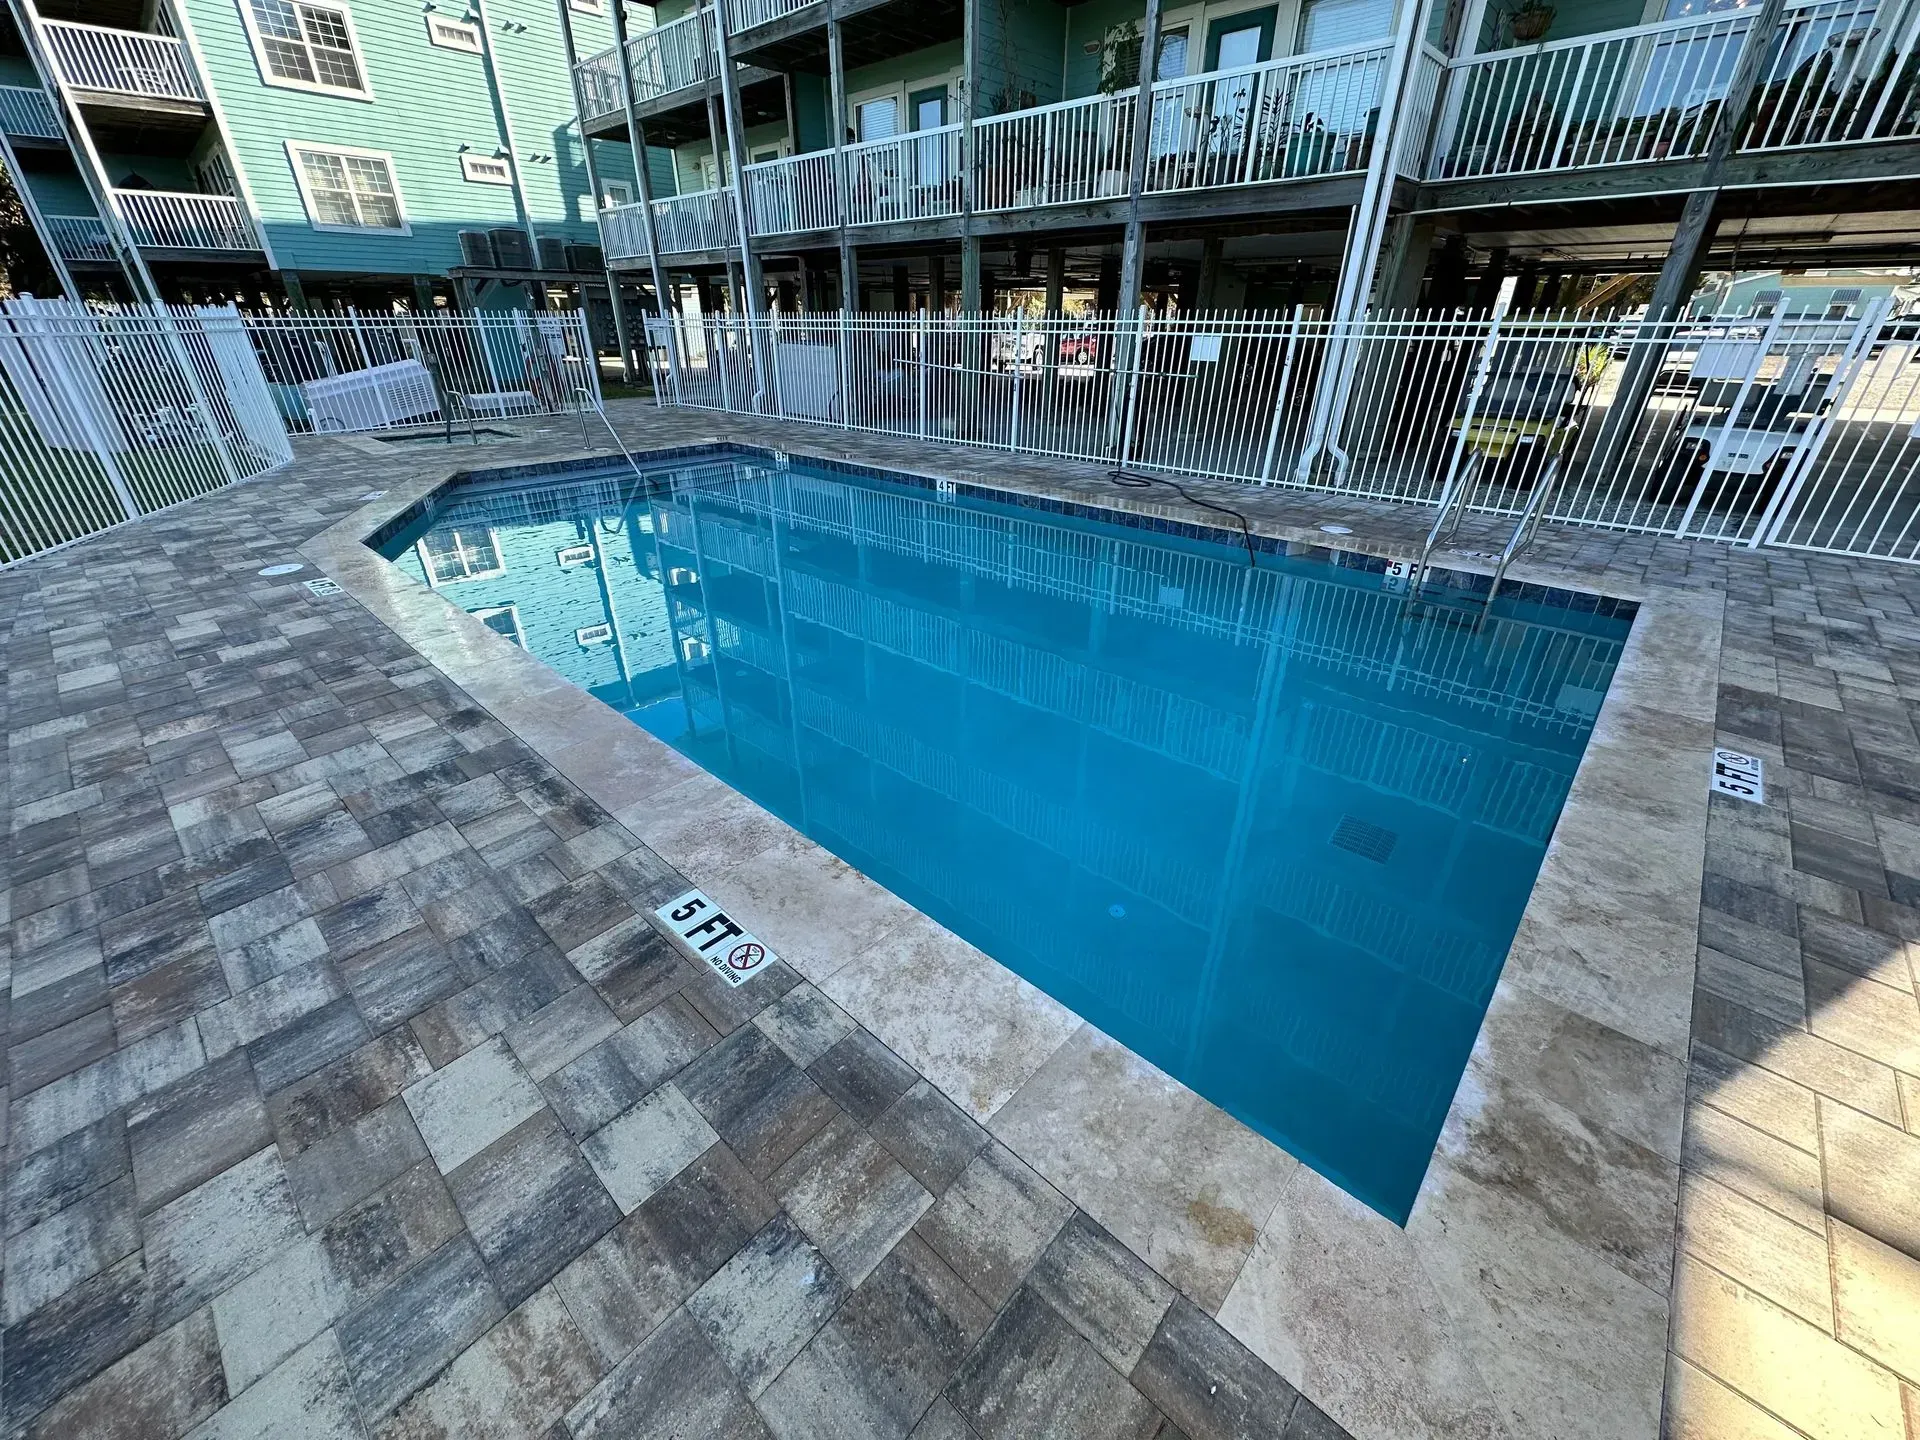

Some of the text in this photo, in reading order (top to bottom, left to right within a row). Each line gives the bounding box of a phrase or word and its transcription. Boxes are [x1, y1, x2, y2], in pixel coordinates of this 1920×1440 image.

[939, 481, 955, 493] 4 FT
[1392, 562, 1402, 576] 5
[1715, 762, 1758, 795] 5 FT
[671, 898, 744, 952] 5 FT
[709, 955, 741, 984] NO DIVING
